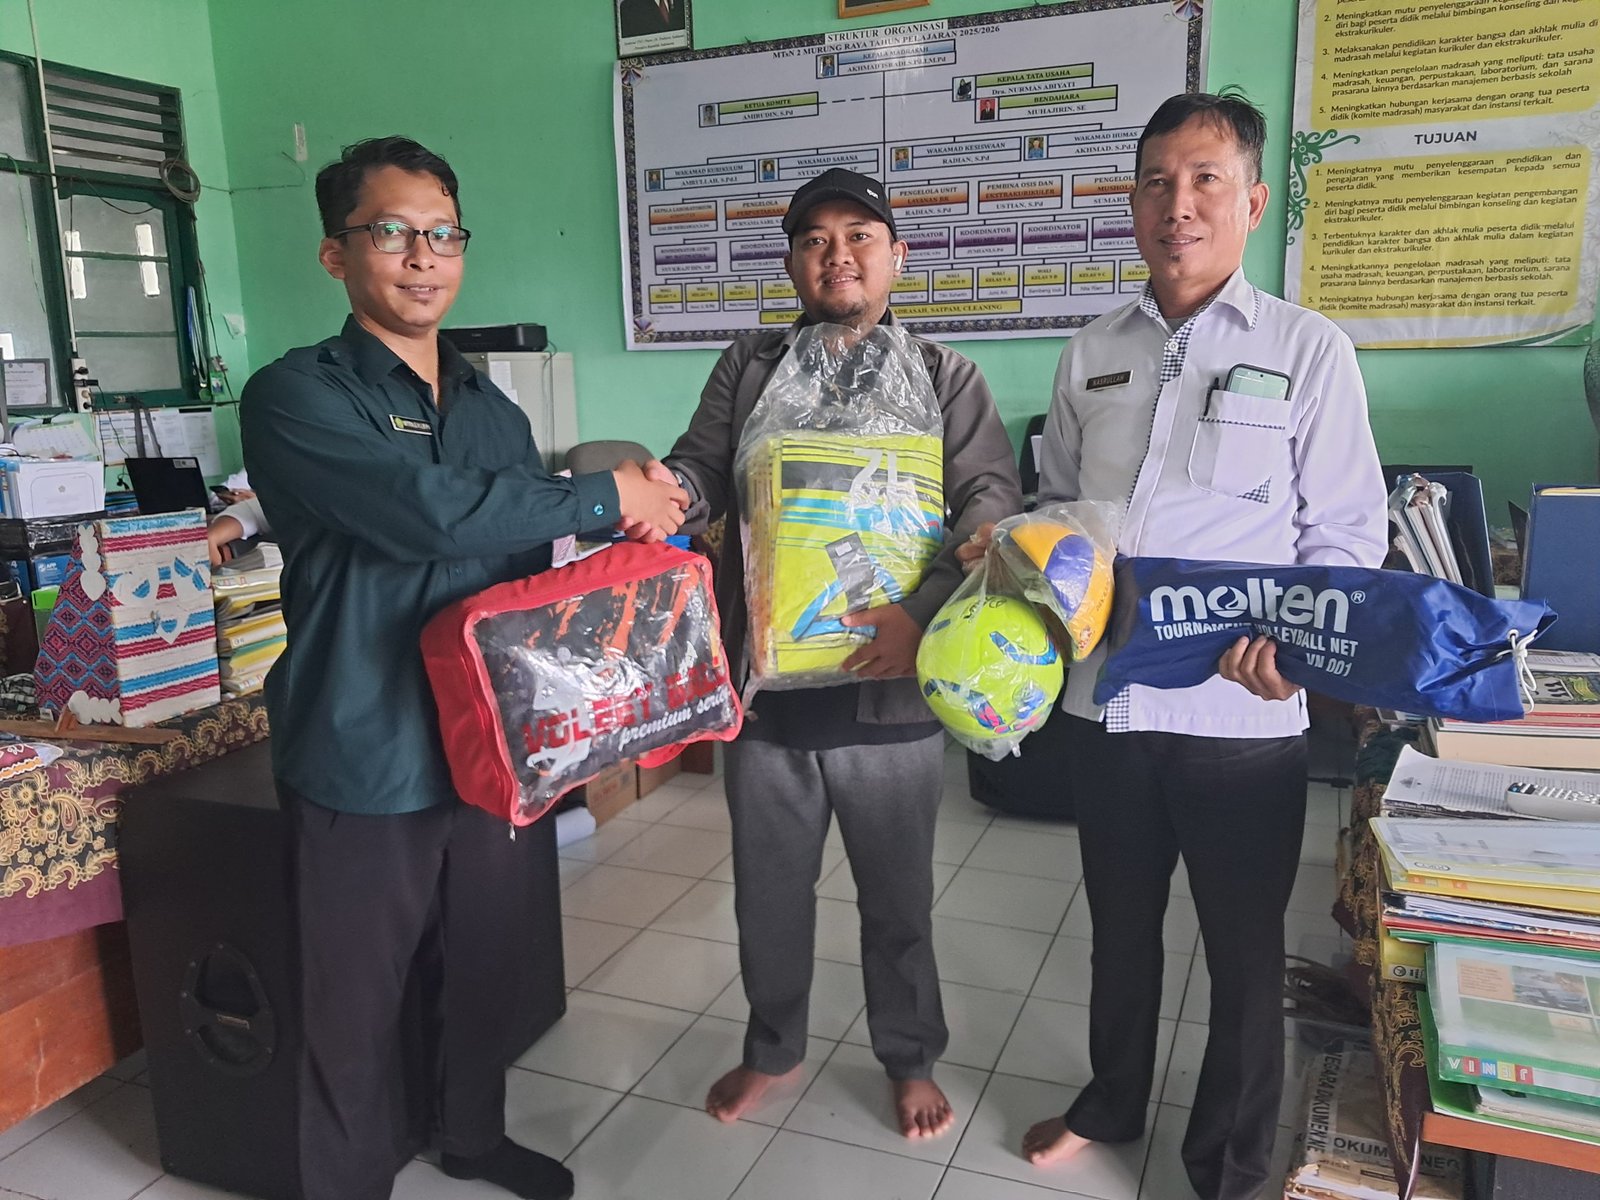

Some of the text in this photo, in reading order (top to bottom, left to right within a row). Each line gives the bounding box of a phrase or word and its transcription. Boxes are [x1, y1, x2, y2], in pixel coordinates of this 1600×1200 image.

[1323, 14, 1330, 22] 2.
[1336, 8, 1391, 21] Meningkatkan
[1394, 5, 1415, 14] mutu
[827, 21, 944, 42] STRUKTUR ORGANISASI
[1322, 18, 1598, 56] 3. Melaksanakan pendidikan karakter bangsa dan akhlak mulia di
[772, 49, 794, 58] MTsN
[802, 43, 842, 54] MURUNG
[844, 40, 867, 50] RAYA
[869, 36, 900, 47] TAHUN
[902, 30, 957, 43] PELAJARAN
[959, 25, 1000, 36] 2025/2026
[1334, 51, 1370, 63] madrasah
[1372, 48, 1400, 59] melalui
[1402, 46, 1436, 58] kegiatan
[1438, 42, 1474, 53] kurikuler
[1476, 41, 1492, 49] dan
[1320, 73, 1328, 81] 4.
[1332, 67, 1388, 80] Meningkatkan
[1390, 63, 1438, 77] pengelolaan
[1440, 58, 1480, 70] madrasah
[1482, 58, 1503, 68] yang
[1546, 50, 1564, 59] tata
[1567, 47, 1594, 57] usaha
[1542, 60, 1558, 68] dan
[1563, 58, 1593, 66] sarana
[996, 74, 1025, 82] KEPALA
[1044, 69, 1070, 78] USAHA
[1008, 84, 1041, 93] NURMAS
[1044, 81, 1075, 89] ABIYATI
[1033, 92, 1080, 103] BENDAHARA
[1318, 83, 1590, 114] 5. Meningkatkan hubungan kerjasama dengan orang tua peserta
[1027, 106, 1075, 115] MUHAJIRIN,
[1329, 111, 1349, 121] didik
[1350, 109, 1380, 121] (komite
[1381, 106, 1422, 117] madrasah)
[1423, 102, 1470, 115] masyarakat
[1471, 101, 1487, 110] dan
[1488, 98, 1521, 108] instansi
[1073, 130, 1138, 141] WAKAMAD HUMAS
[1414, 130, 1477, 145] TUJUAN
[926, 141, 1006, 154] WAKAMAD KESISWAAN
[1327, 165, 1381, 176] Meningkatnya
[1426, 159, 1493, 171] penyelenggaraan
[1506, 154, 1552, 166] pendidikan
[1565, 152, 1581, 160] dan
[1094, 174, 1136, 183] PENGELOL
[1326, 175, 1368, 185] pengajaran
[1375, 174, 1394, 182] yang
[1401, 169, 1450, 178] memberikan
[1457, 166, 1506, 176] kesempatan
[1514, 163, 1544, 173] kepada
[899, 187, 939, 196] PENGELOLA
[986, 182, 1019, 190] PEMBINA
[1020, 180, 1036, 188] OSIS
[1325, 183, 1354, 194] peserta
[1324, 198, 1379, 208] Meningkatnya
[1382, 196, 1403, 204] mutu
[1405, 194, 1473, 205] penyelenggaraan
[1476, 191, 1510, 201] kegiatan
[1513, 188, 1578, 199] pengembangan
[898, 231, 944, 239] OORDINATOR
[959, 227, 1011, 235] KOORDINATOR
[1027, 223, 1081, 231] KOORDINATOR
[1150, 578, 1349, 633] molten
[1331, 637, 1358, 657] NET
[1306, 652, 1352, 677] VN 001
[618, 710, 692, 751] premium
